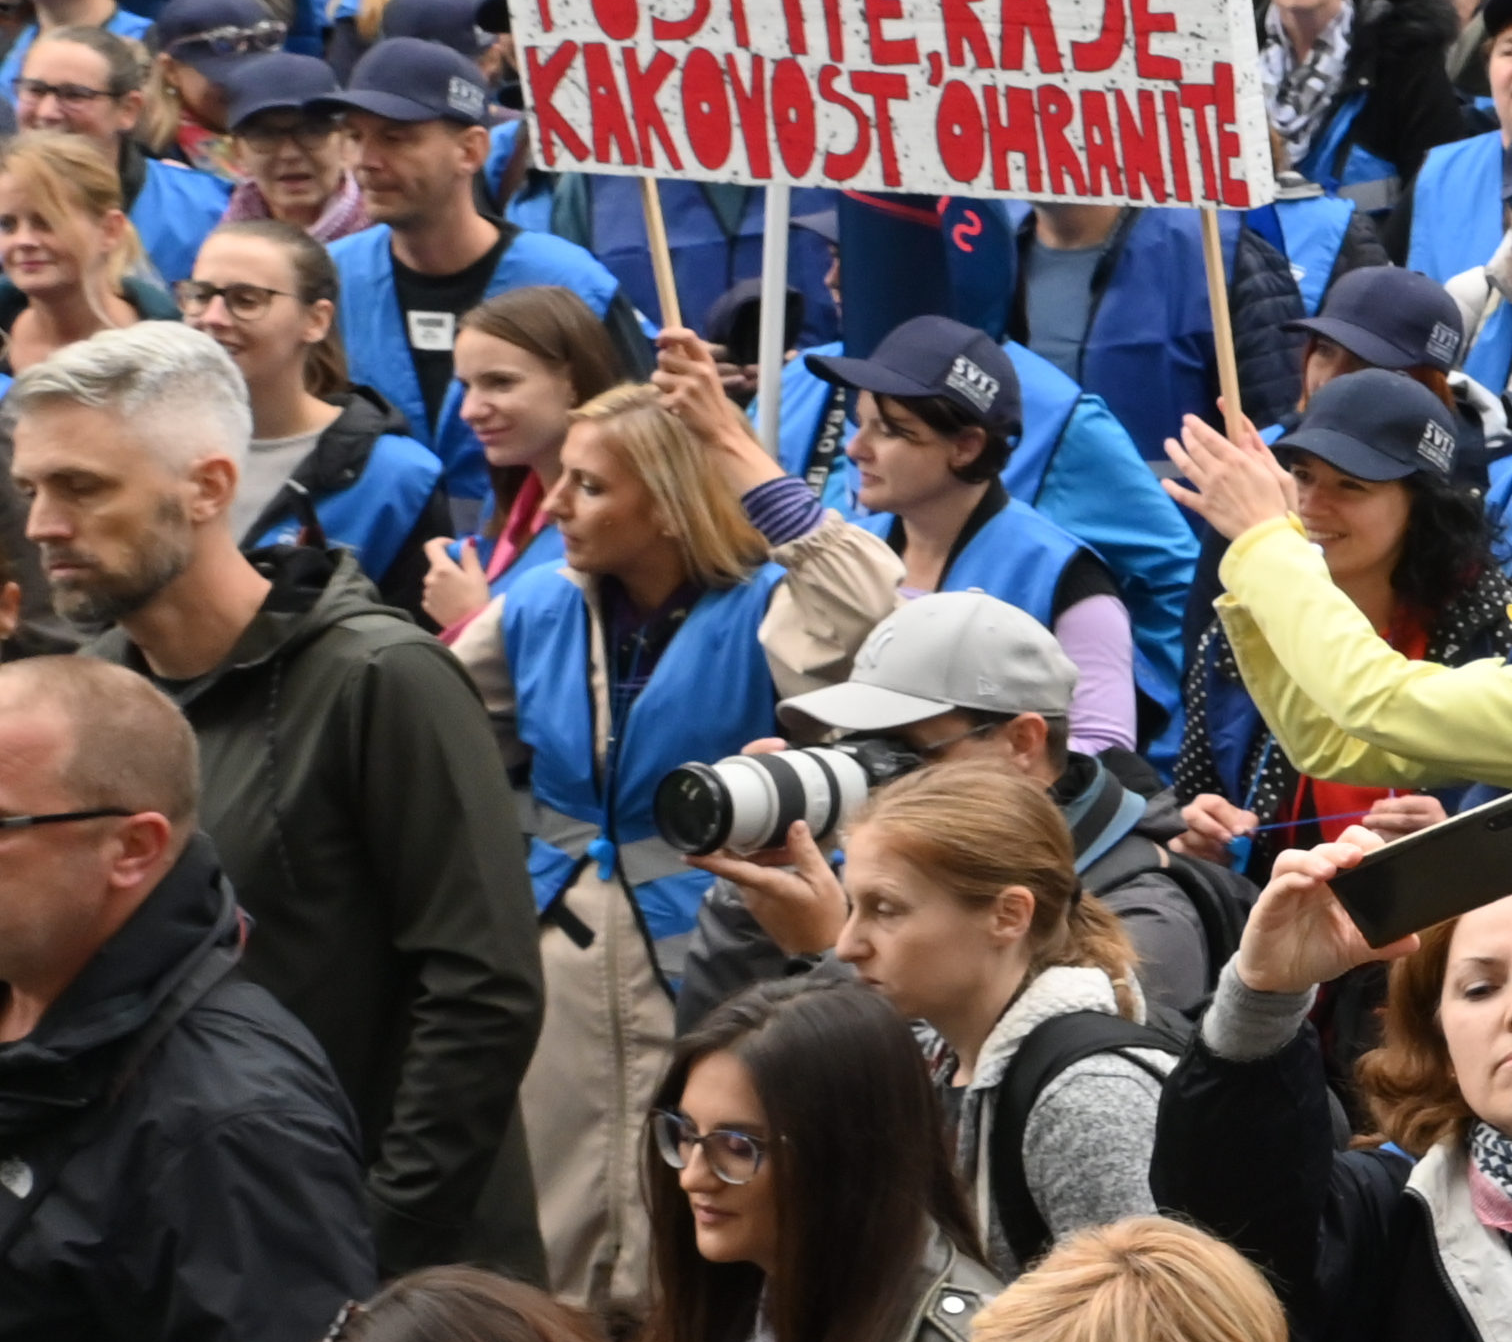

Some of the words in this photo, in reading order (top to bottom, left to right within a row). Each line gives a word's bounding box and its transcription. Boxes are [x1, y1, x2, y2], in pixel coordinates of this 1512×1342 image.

[526, 41, 909, 187] KAKOVOST
[937, 61, 1250, 209] OHRANITE
[952, 358, 1000, 401] SVIZ
